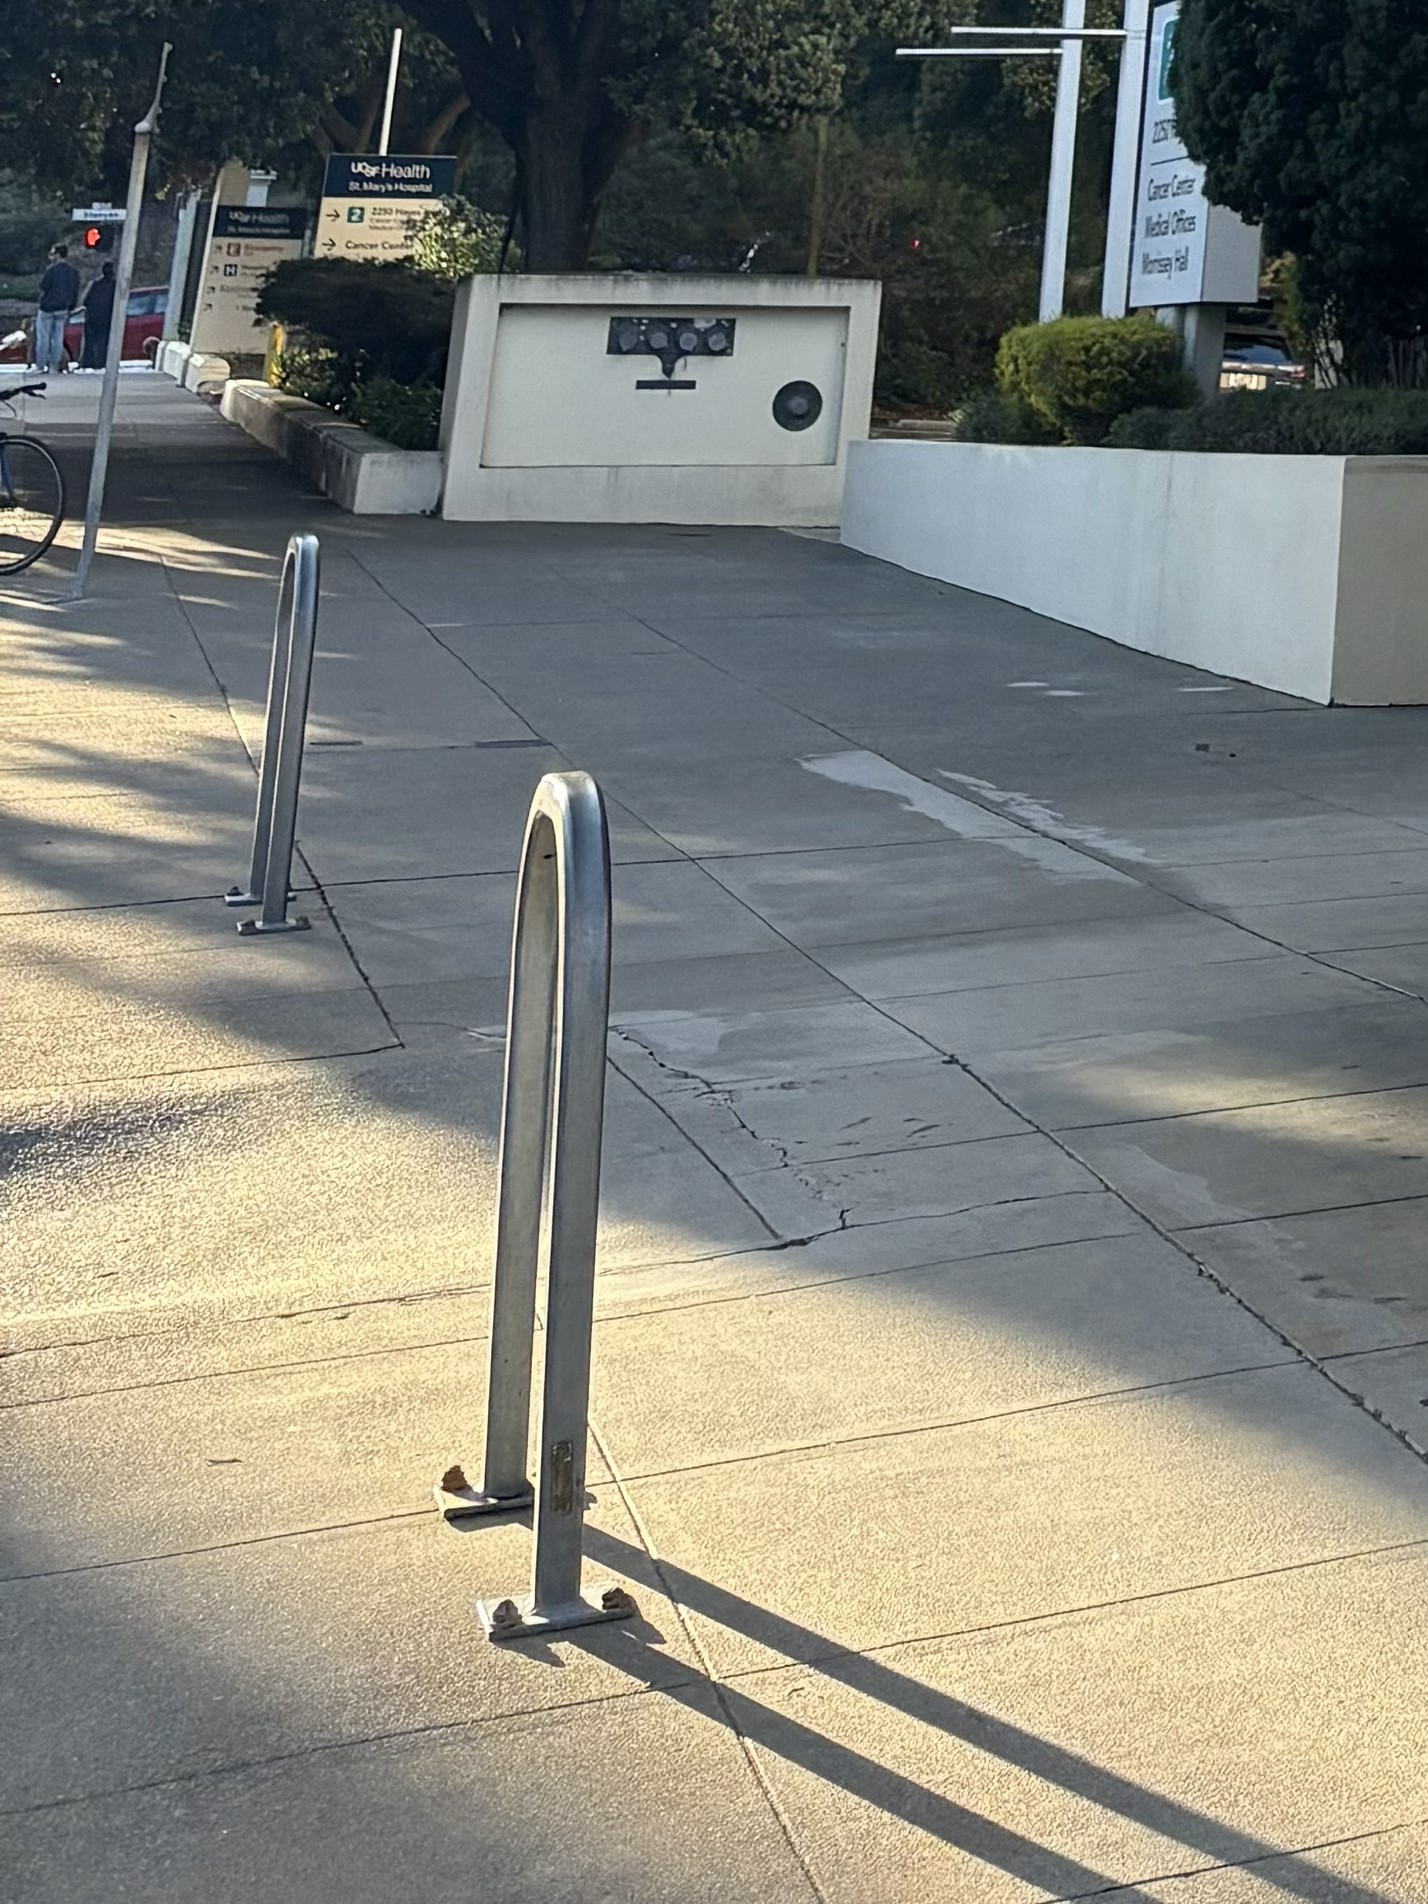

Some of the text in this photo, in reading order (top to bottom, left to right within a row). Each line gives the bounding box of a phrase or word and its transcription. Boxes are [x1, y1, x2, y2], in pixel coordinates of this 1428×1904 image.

[381, 162, 430, 179] Health
[394, 182, 433, 193] Hospital
[1147, 173, 1196, 202] Cancer Center
[351, 208, 361, 222] 2
